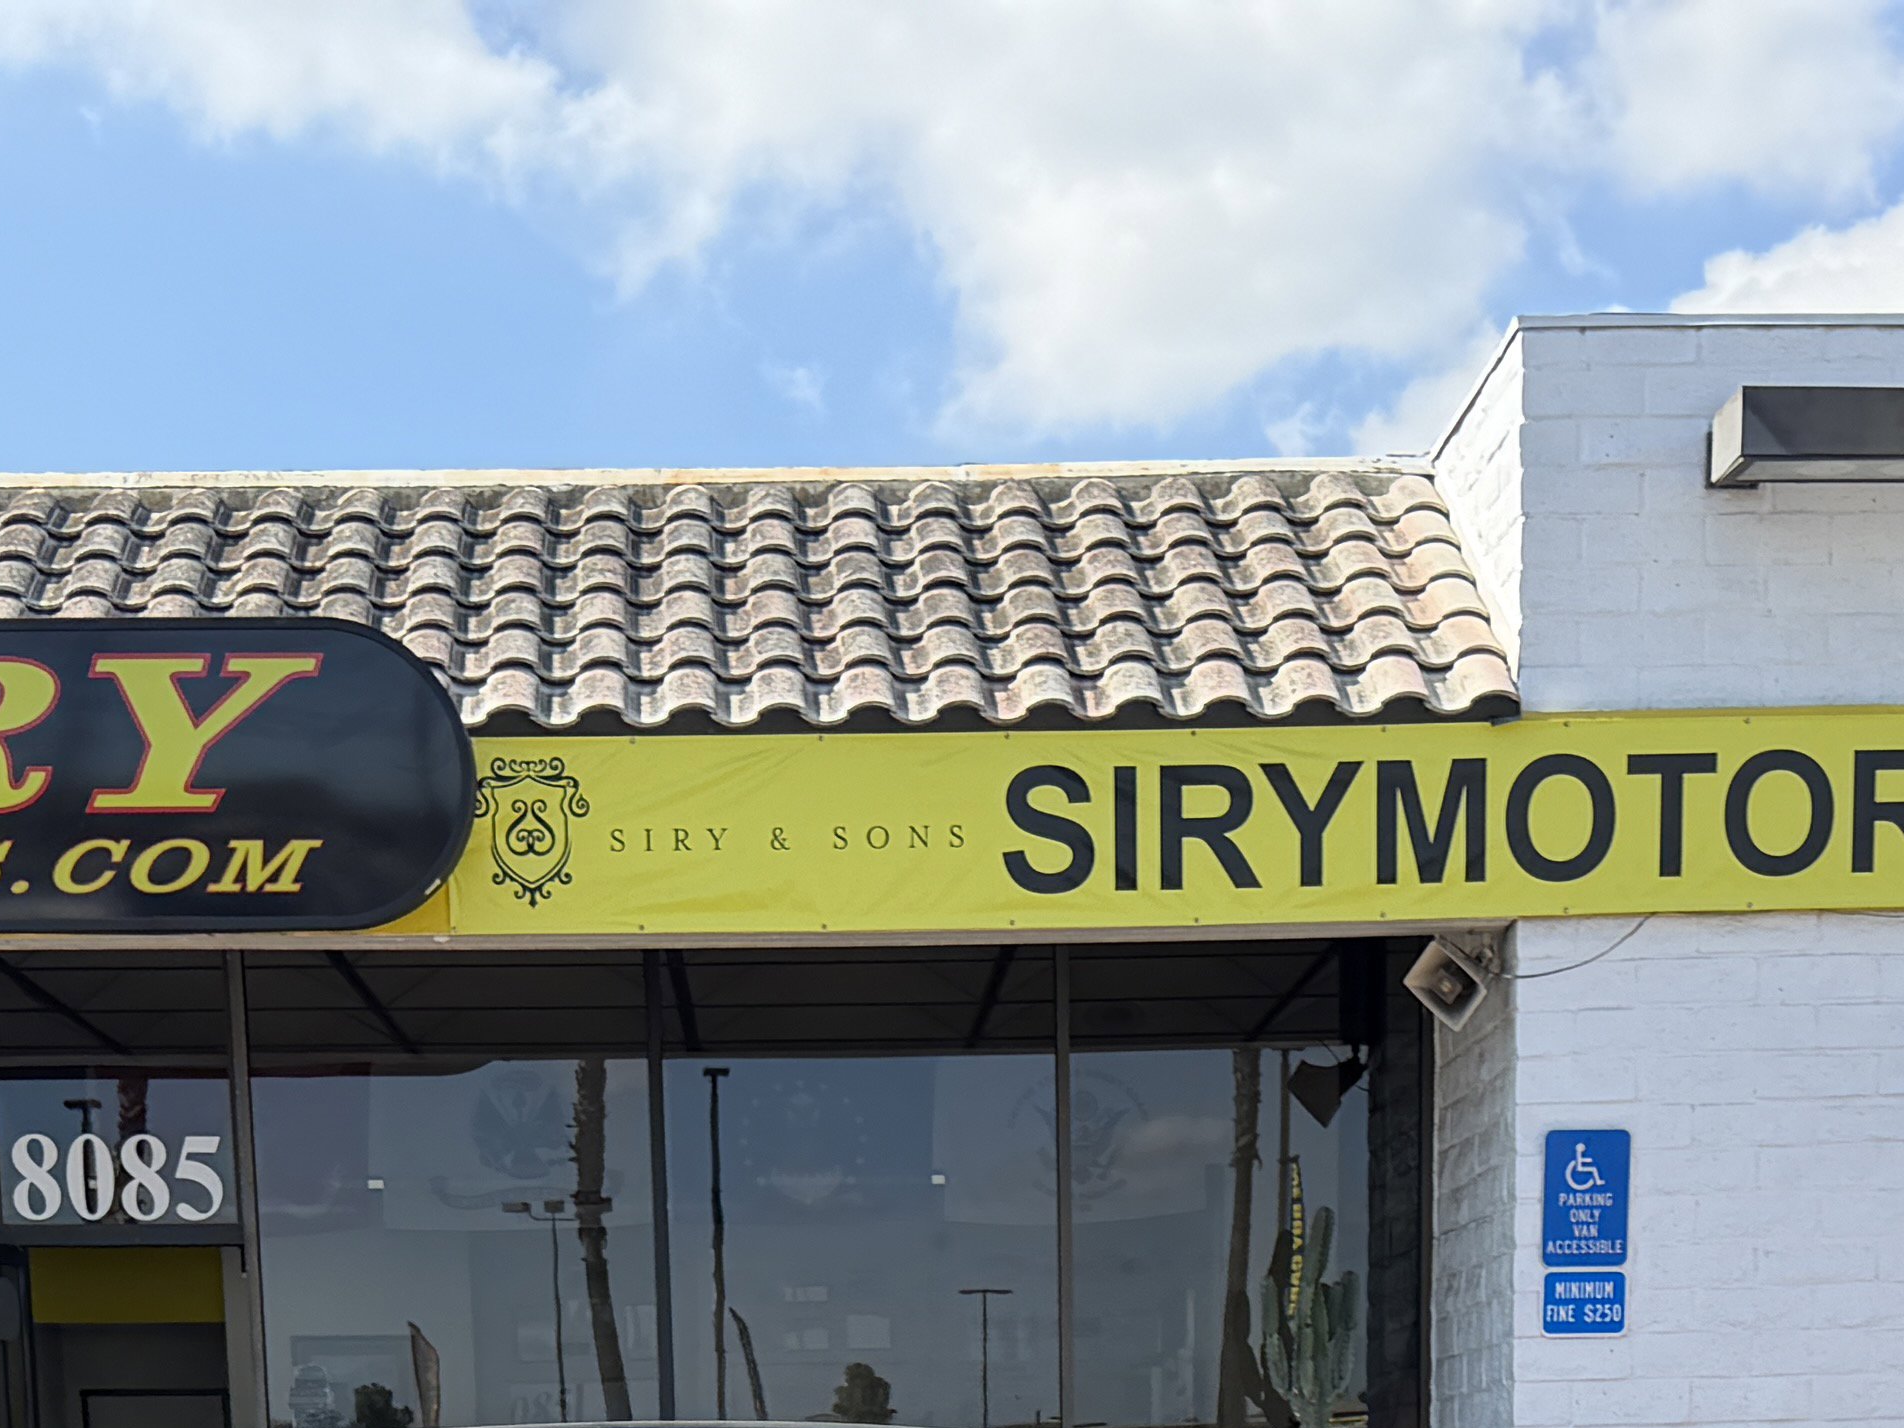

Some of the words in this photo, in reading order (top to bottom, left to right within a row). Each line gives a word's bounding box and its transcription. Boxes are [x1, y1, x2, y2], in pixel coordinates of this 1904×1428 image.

[608, 827, 729, 855] SIRY
[769, 826, 792, 852] &
[832, 823, 967, 852] SONS
[11, 1133, 224, 1222] 8085
[1558, 1192, 1614, 1208] PARKING
[1569, 1208, 1602, 1223] ONLY
[1572, 1224, 1599, 1238] VAN
[1546, 1239, 1624, 1255] ACCESSIBLE
[1555, 1281, 1615, 1300] MINIMUM
[1546, 1304, 1576, 1323] FINE
[1584, 1304, 1622, 1324] $250
